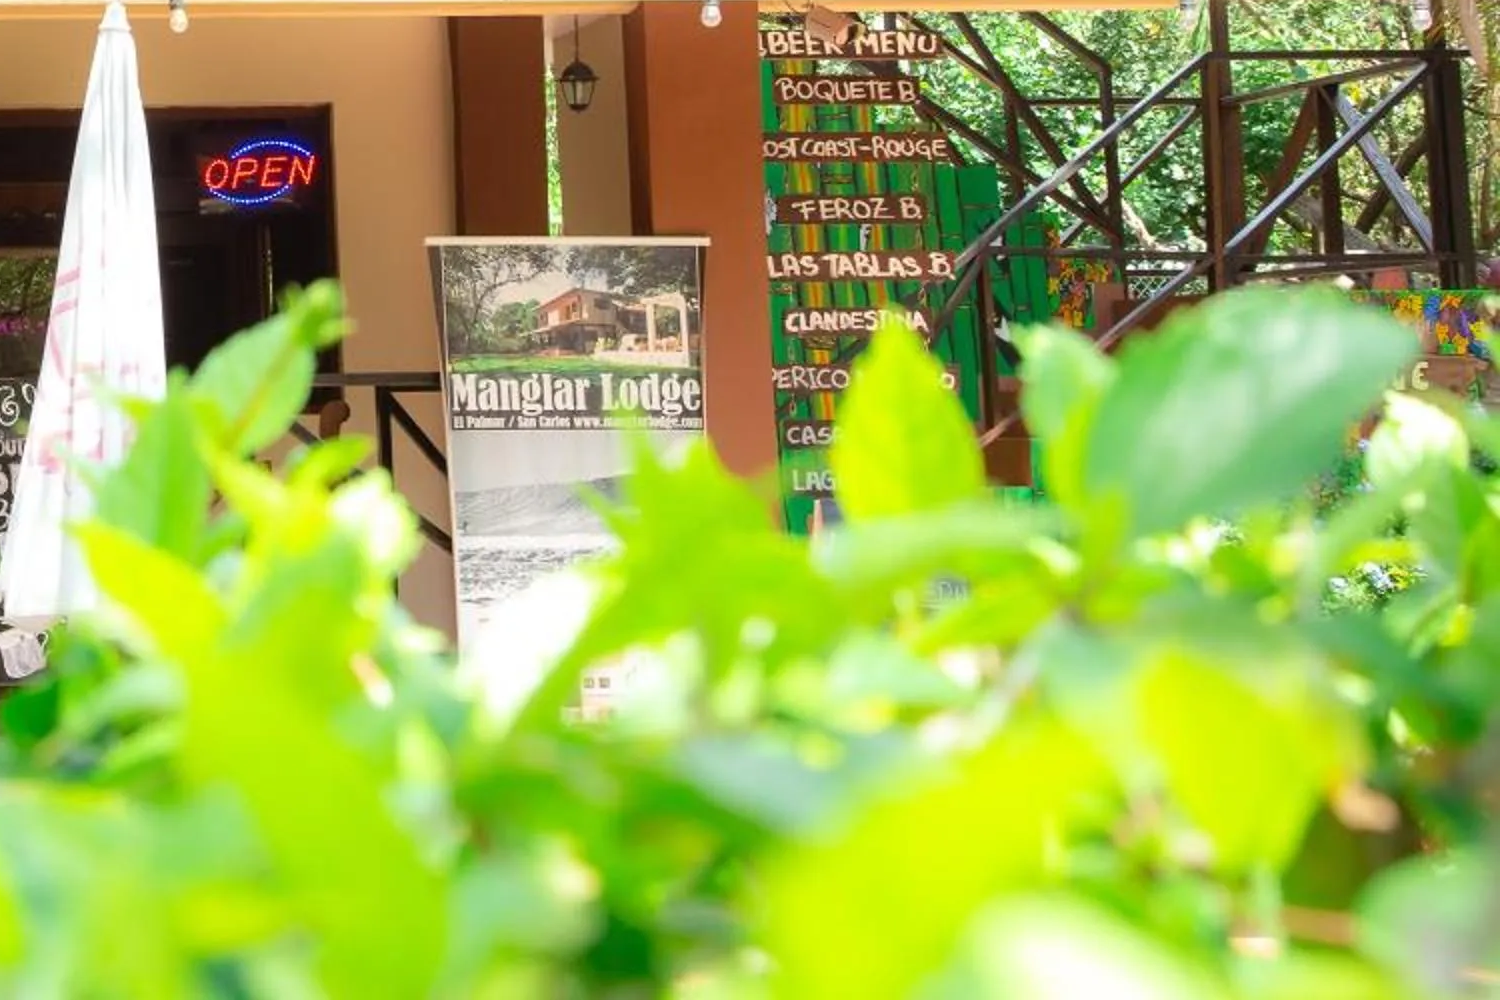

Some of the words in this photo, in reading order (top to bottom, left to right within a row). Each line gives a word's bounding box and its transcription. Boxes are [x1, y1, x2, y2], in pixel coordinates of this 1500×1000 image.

[854, 31, 938, 56] MENU
[775, 77, 893, 103] BOQUETE
[205, 155, 315, 189] OPEN
[791, 197, 895, 220] FEROZ
[767, 253, 819, 278] LAS
[822, 252, 922, 279] TABLAS
[785, 309, 929, 333] CLANDESTNA
[451, 373, 590, 415] Manglar
[601, 373, 701, 414] Lodge
[517, 416, 537, 429] San
